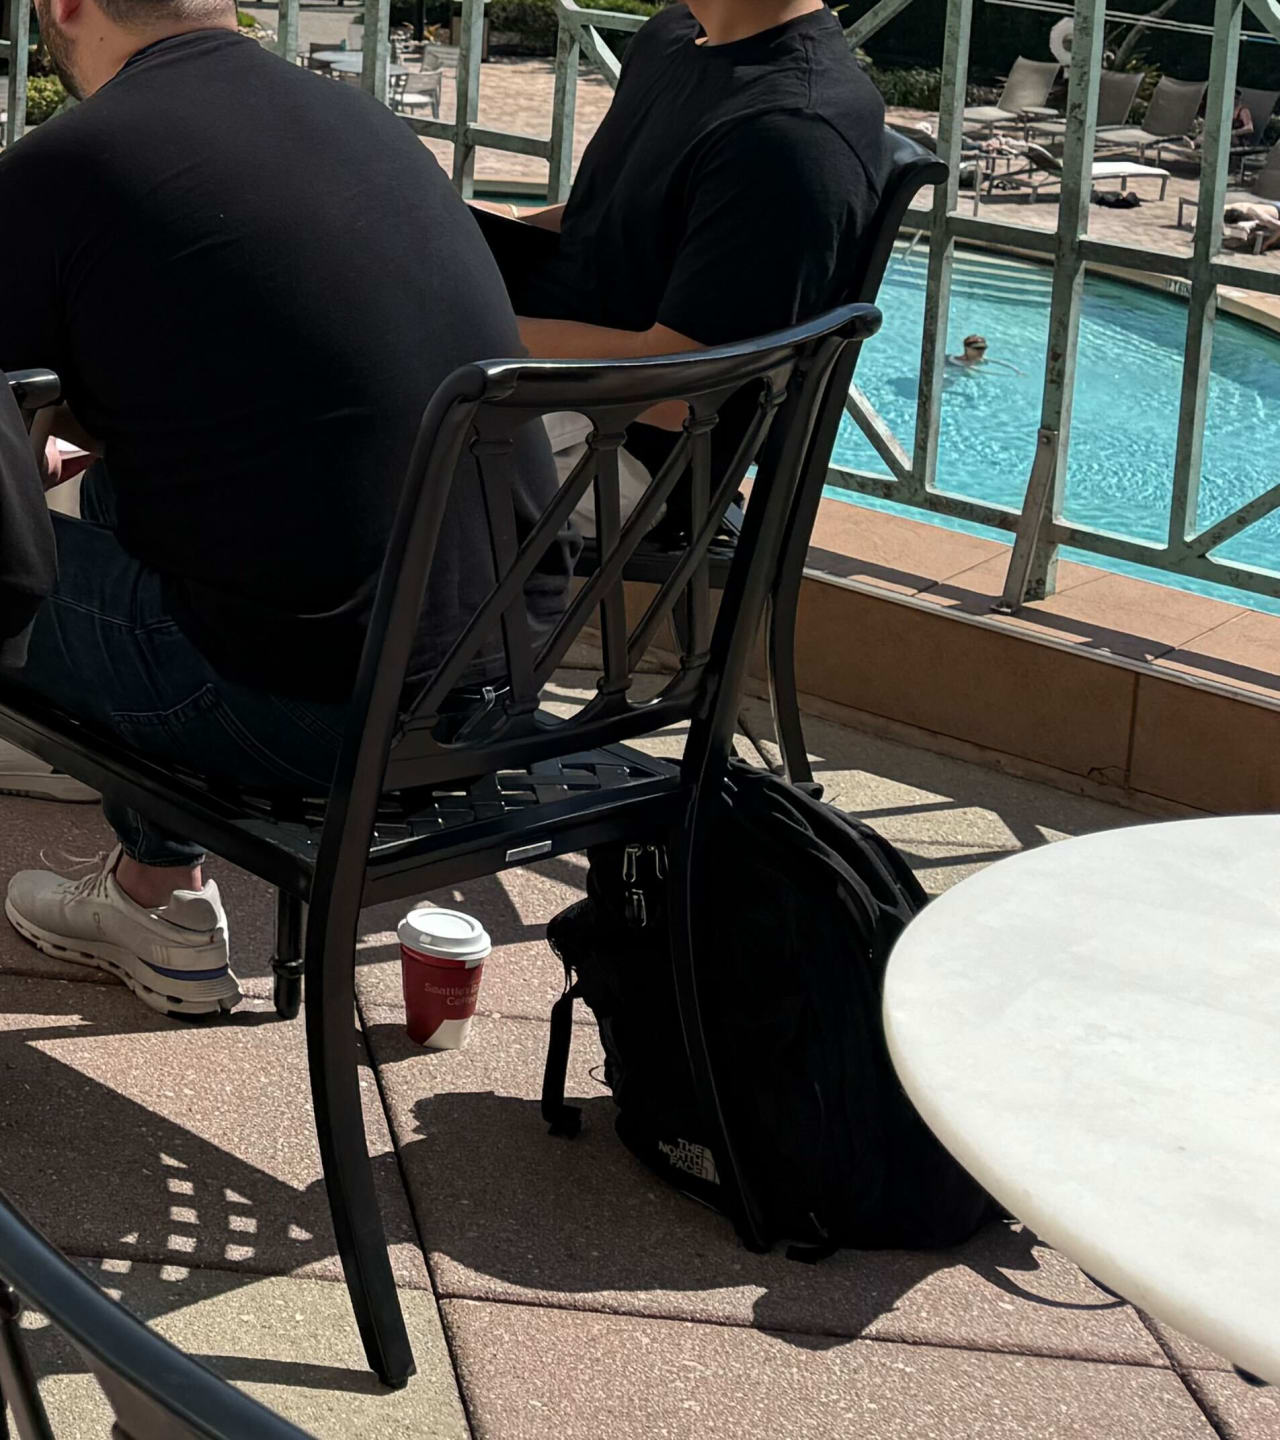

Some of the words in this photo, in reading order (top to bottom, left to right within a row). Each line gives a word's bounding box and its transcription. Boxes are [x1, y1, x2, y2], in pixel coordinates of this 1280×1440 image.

[659, 1140, 703, 1166] NORTH
[677, 1138, 703, 1155] THE
[670, 1154, 703, 1177] FACE
